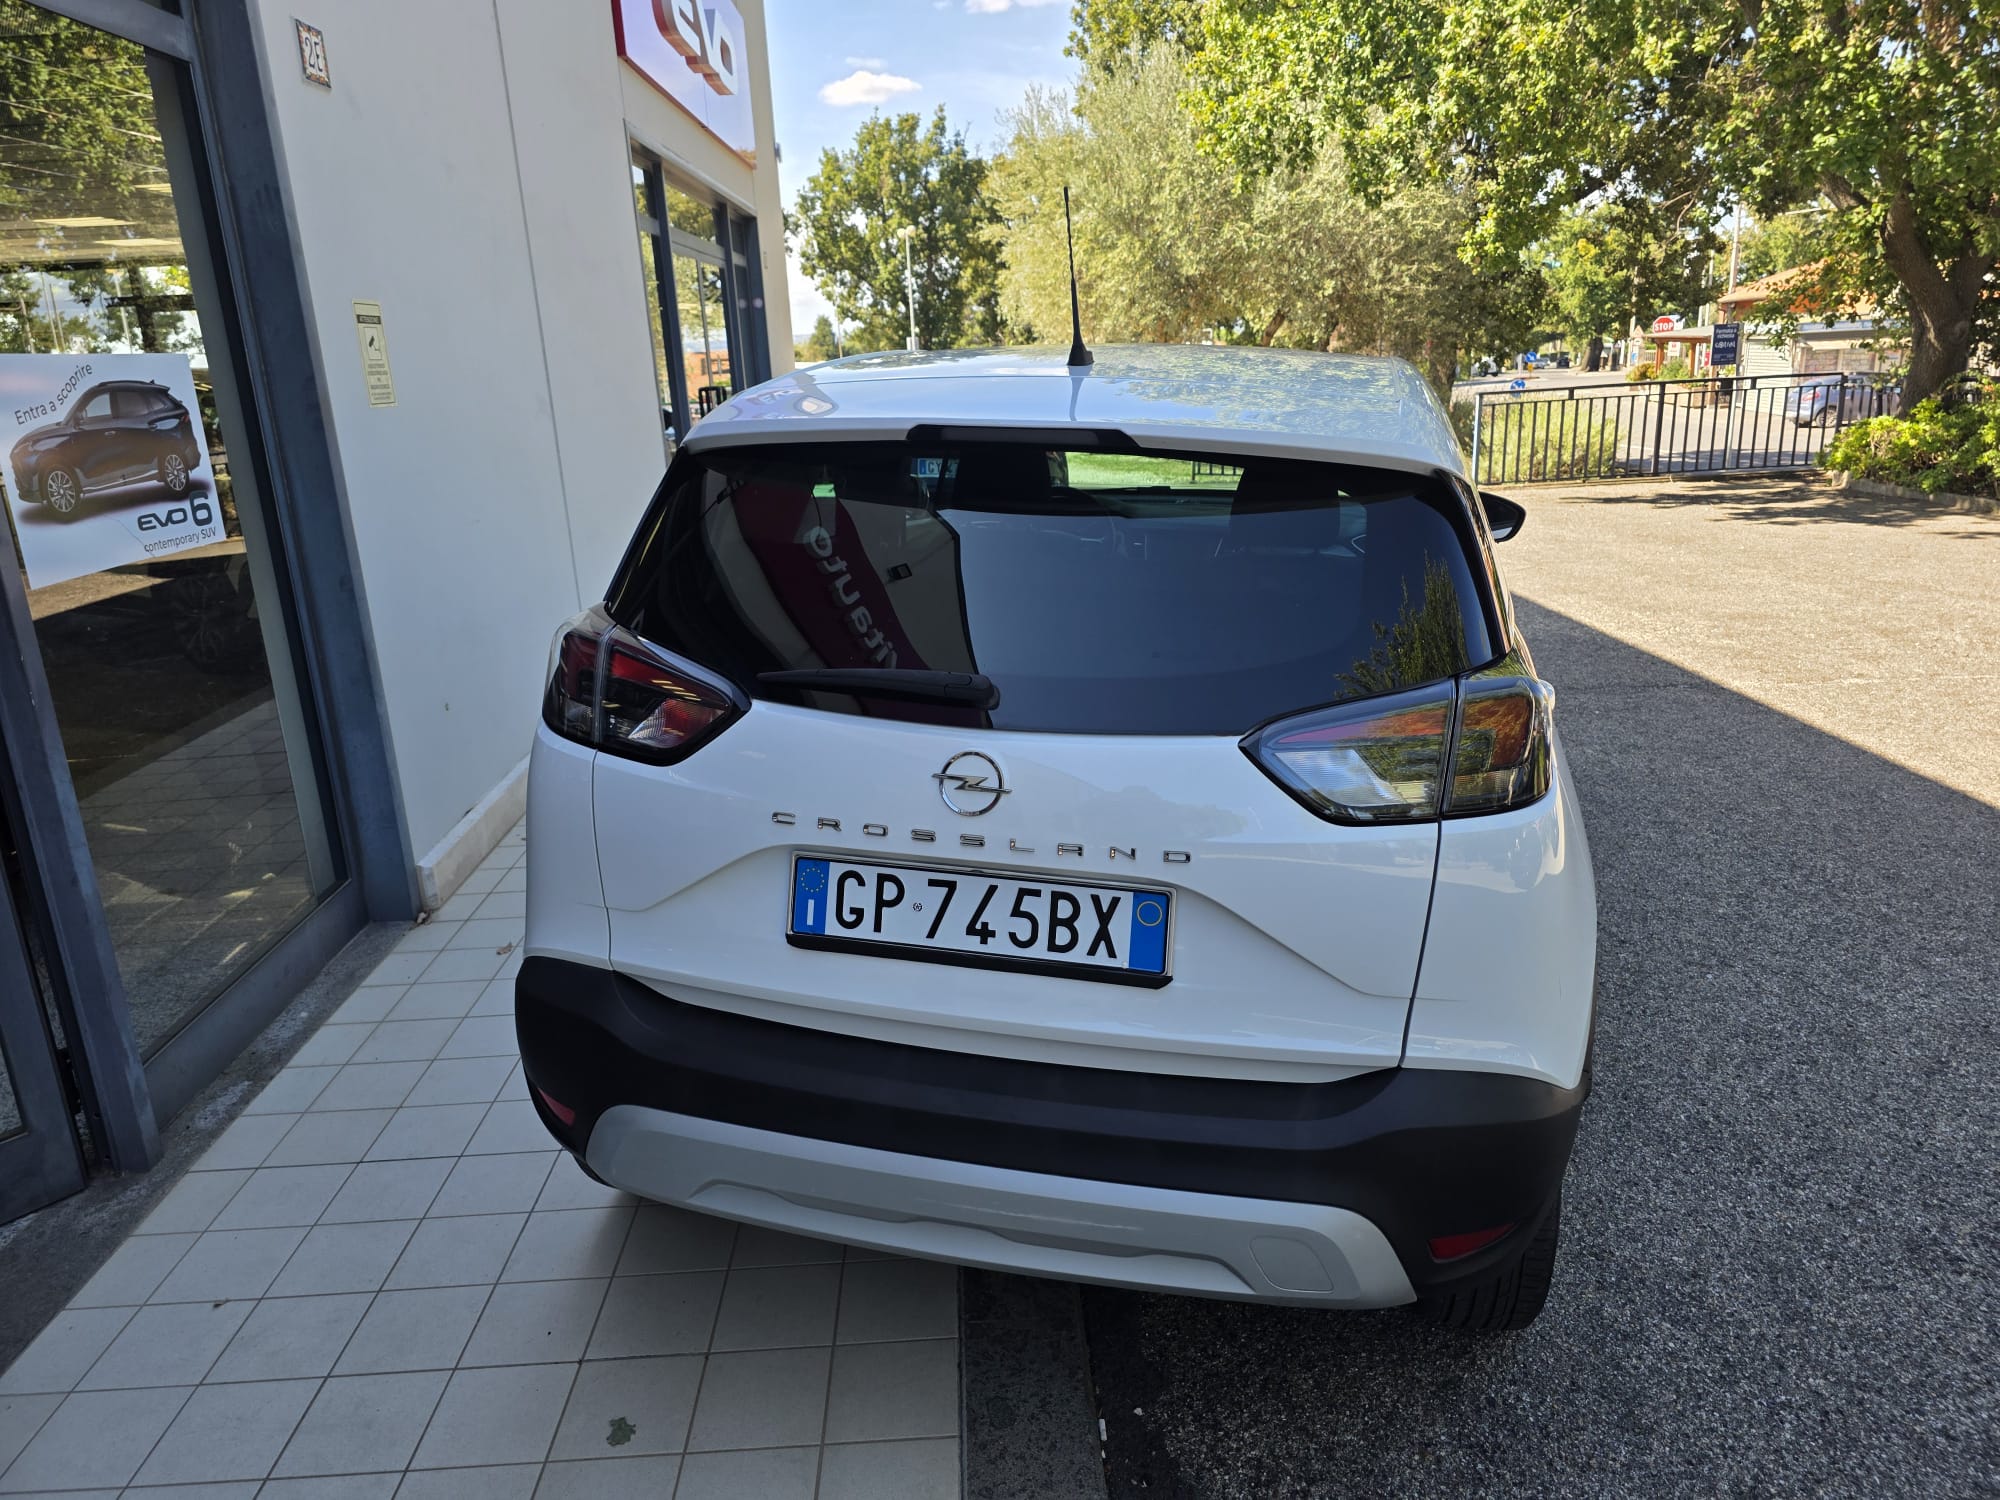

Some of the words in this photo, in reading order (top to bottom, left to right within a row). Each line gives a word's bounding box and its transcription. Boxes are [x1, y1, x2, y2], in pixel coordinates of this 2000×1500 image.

[1654, 322, 1674, 331] STOP
[15, 404, 48, 426] Entra
[50, 400, 57, 412] a
[57, 362, 93, 406] scoprire
[144, 532, 200, 553] contemporary
[201, 526, 217, 540] SUV
[771, 811, 1192, 864] CROSSLAND
